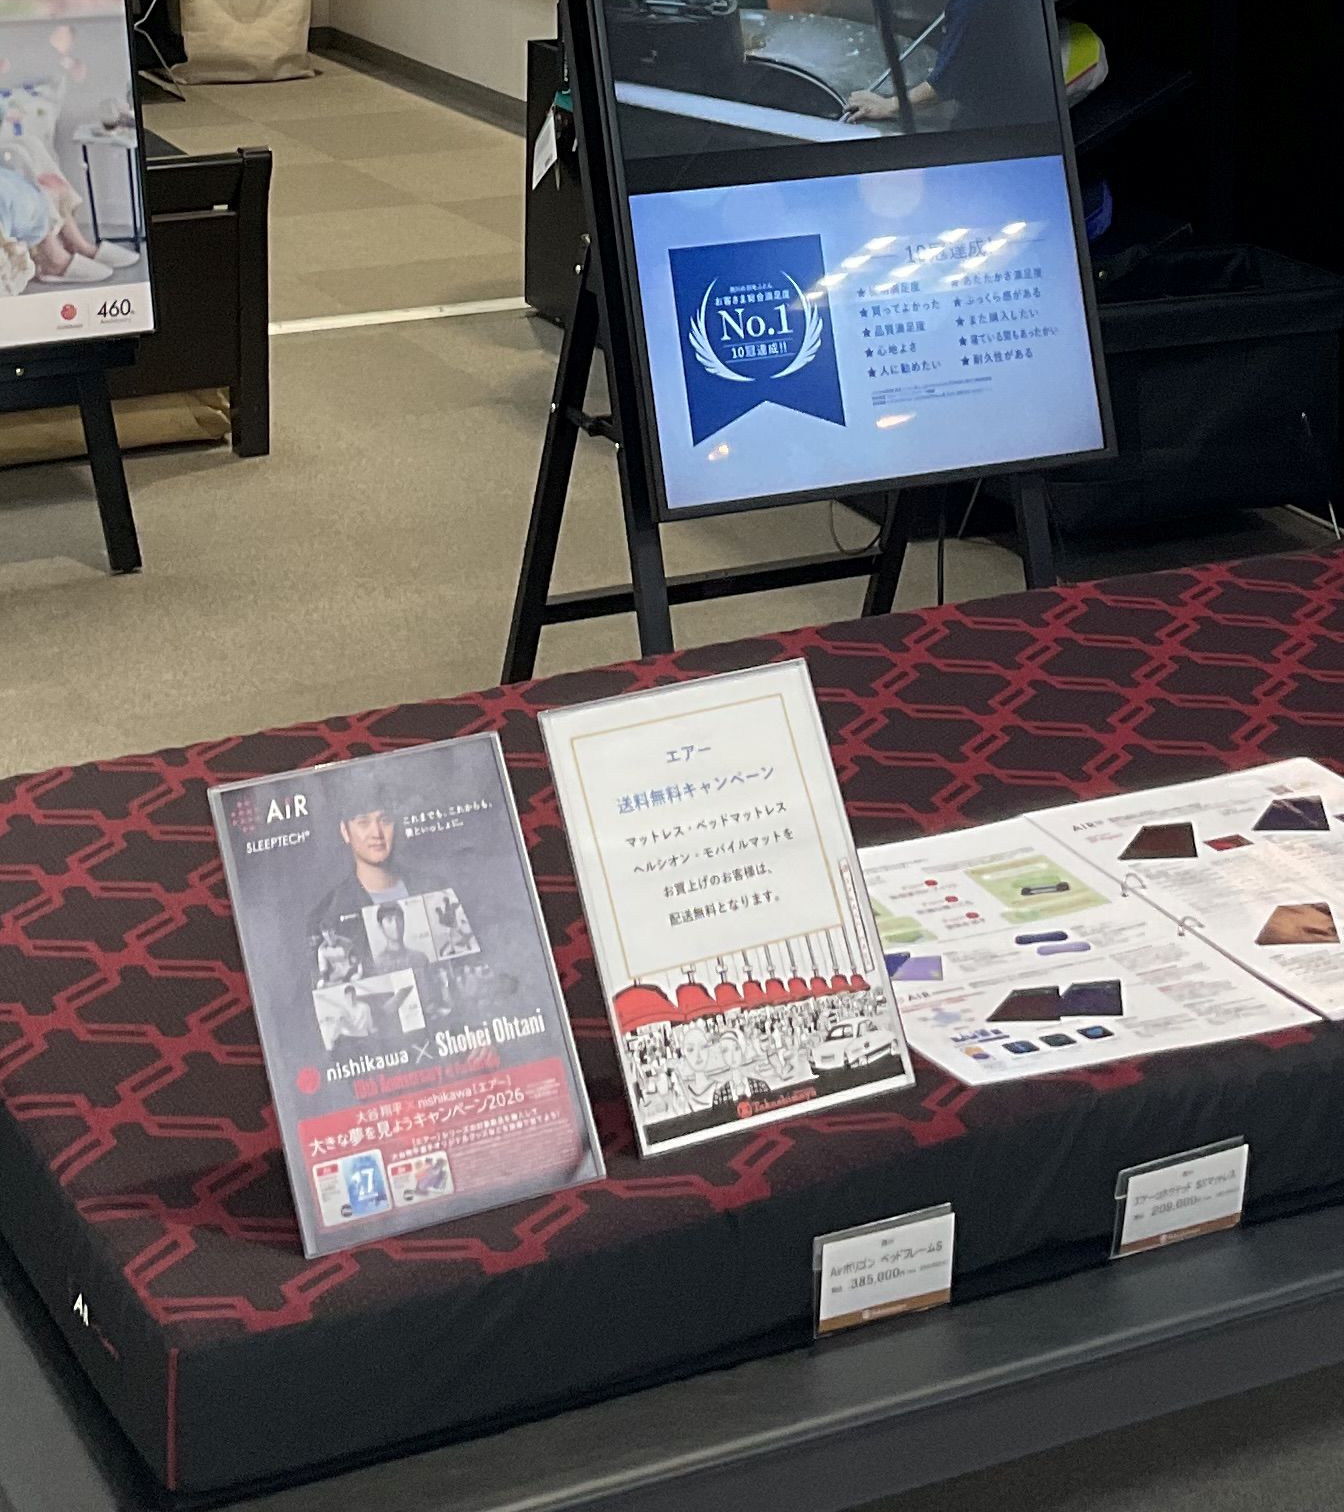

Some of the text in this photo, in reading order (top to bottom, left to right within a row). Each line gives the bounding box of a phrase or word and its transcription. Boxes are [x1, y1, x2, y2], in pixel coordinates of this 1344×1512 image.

[717, 302, 795, 342] No.1
[870, 298, 941, 318] 買ってよかった
[876, 341, 918, 357] 心地よさ
[972, 347, 1034, 366] 耐久性がある
[665, 744, 712, 764] エアー
[616, 766, 775, 815] 送料無料キャンペーン
[266, 794, 309, 823] AiR
[663, 862, 774, 898] お買上げのお客様は、
[668, 889, 780, 927] 配送無料となります。
[326, 1049, 409, 1082] nishikawa
[435, 1025, 491, 1058] Shohei
[492, 1007, 546, 1044] Ohtani
